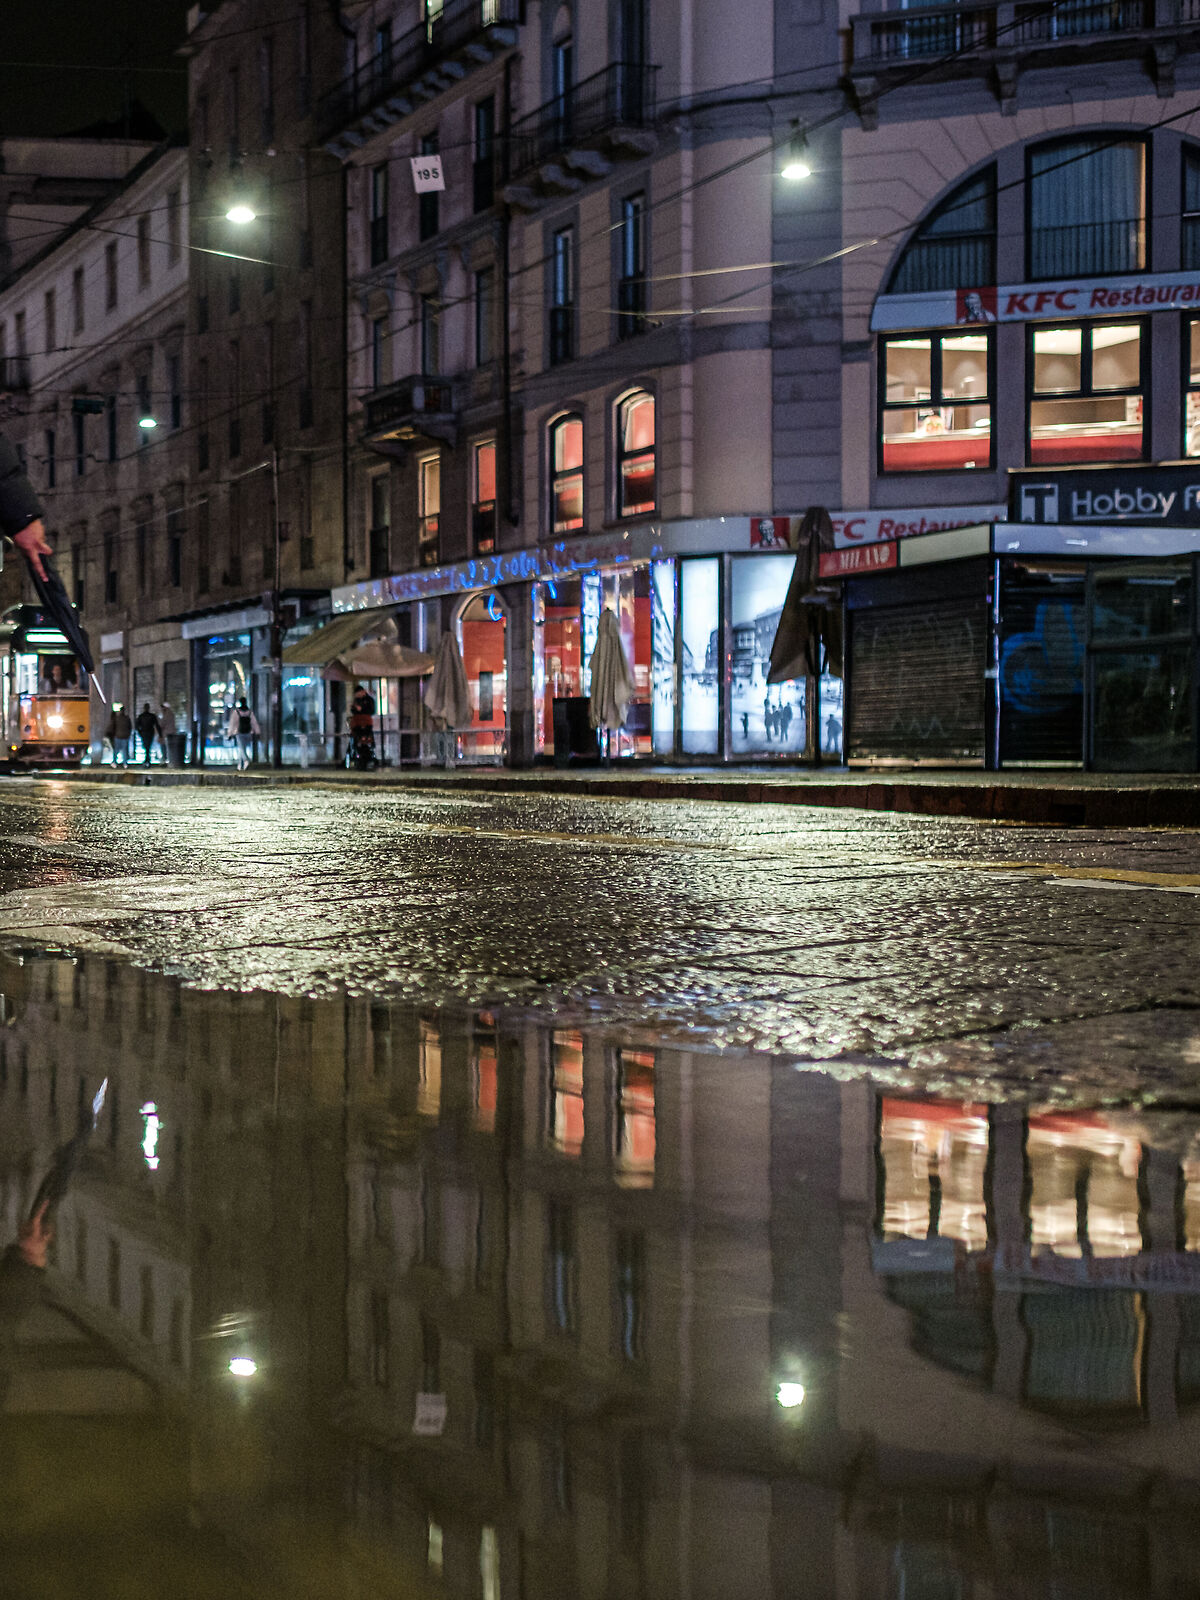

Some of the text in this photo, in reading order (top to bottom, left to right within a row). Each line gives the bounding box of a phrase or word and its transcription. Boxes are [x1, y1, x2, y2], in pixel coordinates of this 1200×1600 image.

[416, 167, 440, 181] 195
[1005, 288, 1081, 315] KFC
[1071, 488, 1178, 520] Hobby
[831, 519, 867, 540] FC
